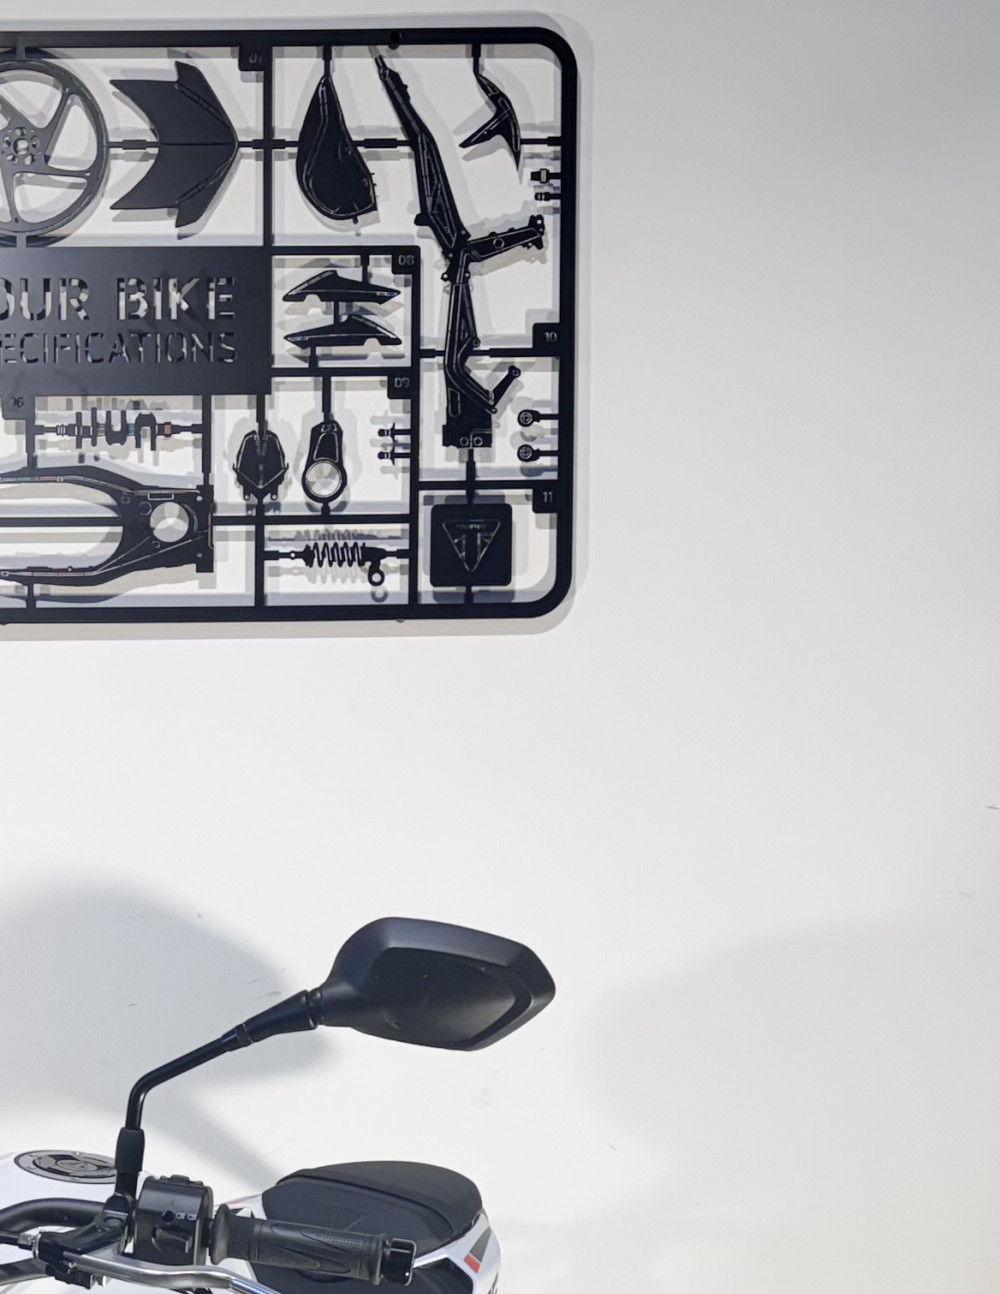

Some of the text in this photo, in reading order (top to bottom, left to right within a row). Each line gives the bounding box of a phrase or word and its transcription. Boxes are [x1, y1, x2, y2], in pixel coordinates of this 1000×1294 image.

[397, 254, 415, 266] 08
[116, 277, 236, 321] BIKE
[544, 332, 558, 343] 10
[394, 377, 410, 389] 09
[9, 396, 24, 409] 06
[542, 491, 554, 503] 11
